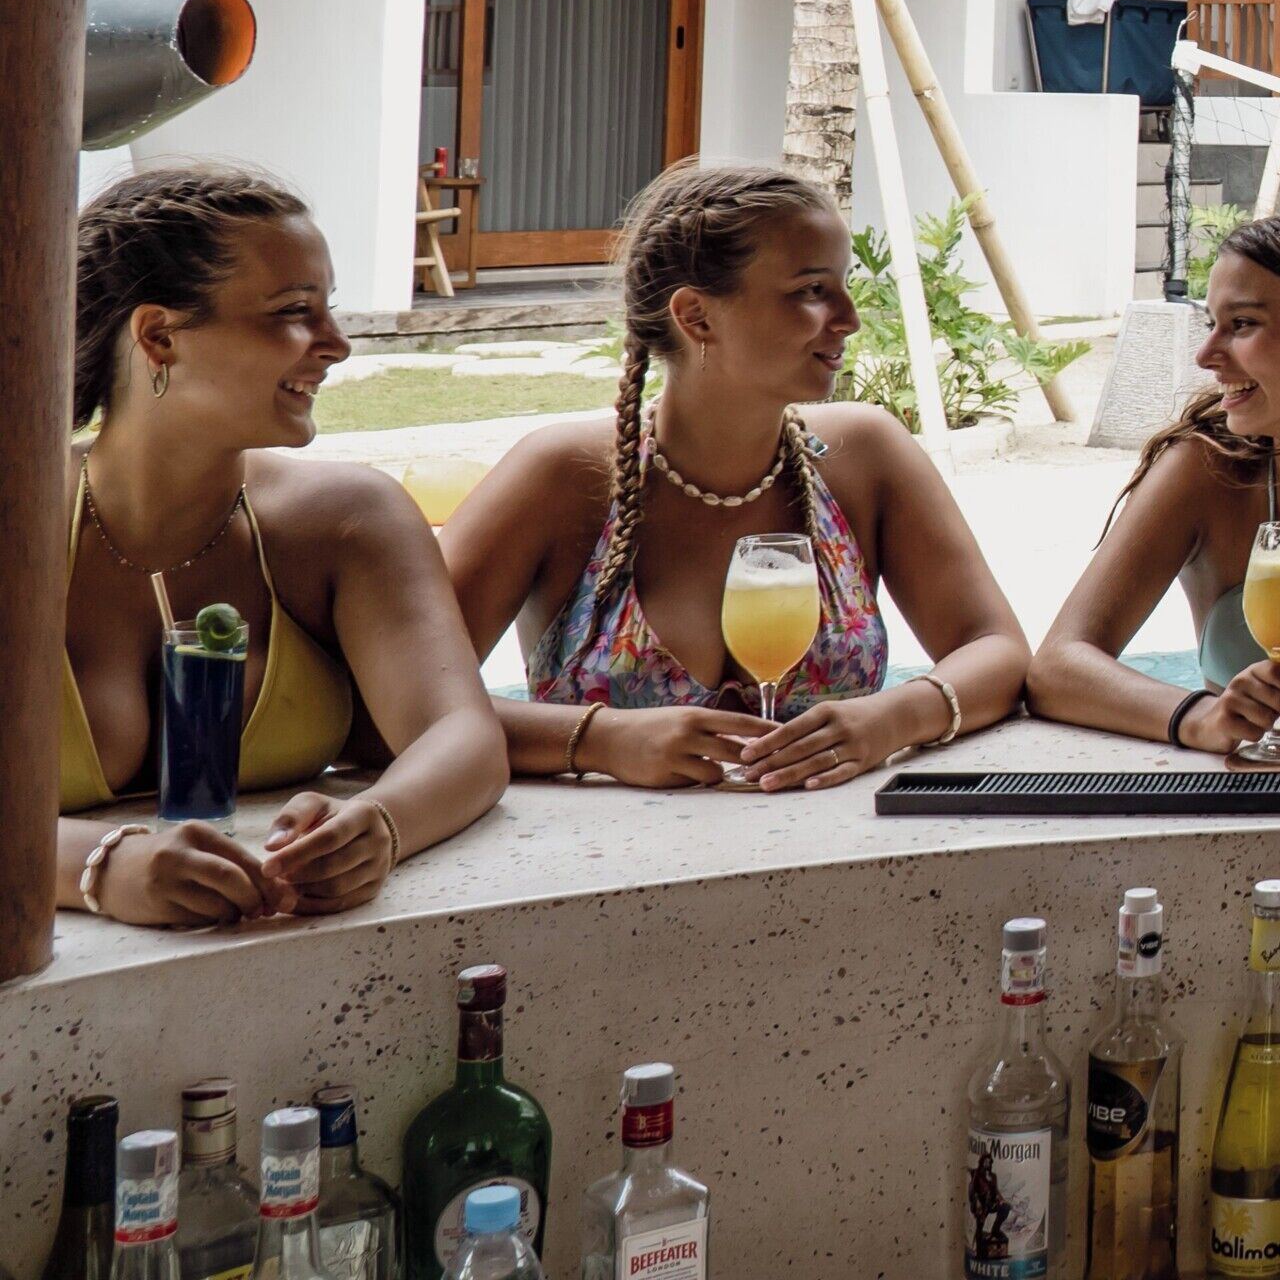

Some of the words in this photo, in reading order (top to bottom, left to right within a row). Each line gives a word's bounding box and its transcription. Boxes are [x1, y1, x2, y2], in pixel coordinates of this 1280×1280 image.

[990, 1138, 1041, 1163] Morgan
[264, 1167, 302, 1185] Captain
[266, 1184, 302, 1199] Morgan
[123, 1208, 161, 1222] Morgan
[630, 1240, 699, 1276] BEEFEATER
[646, 1261, 682, 1274] LONDON
[968, 1260, 1011, 1279] WHITE
